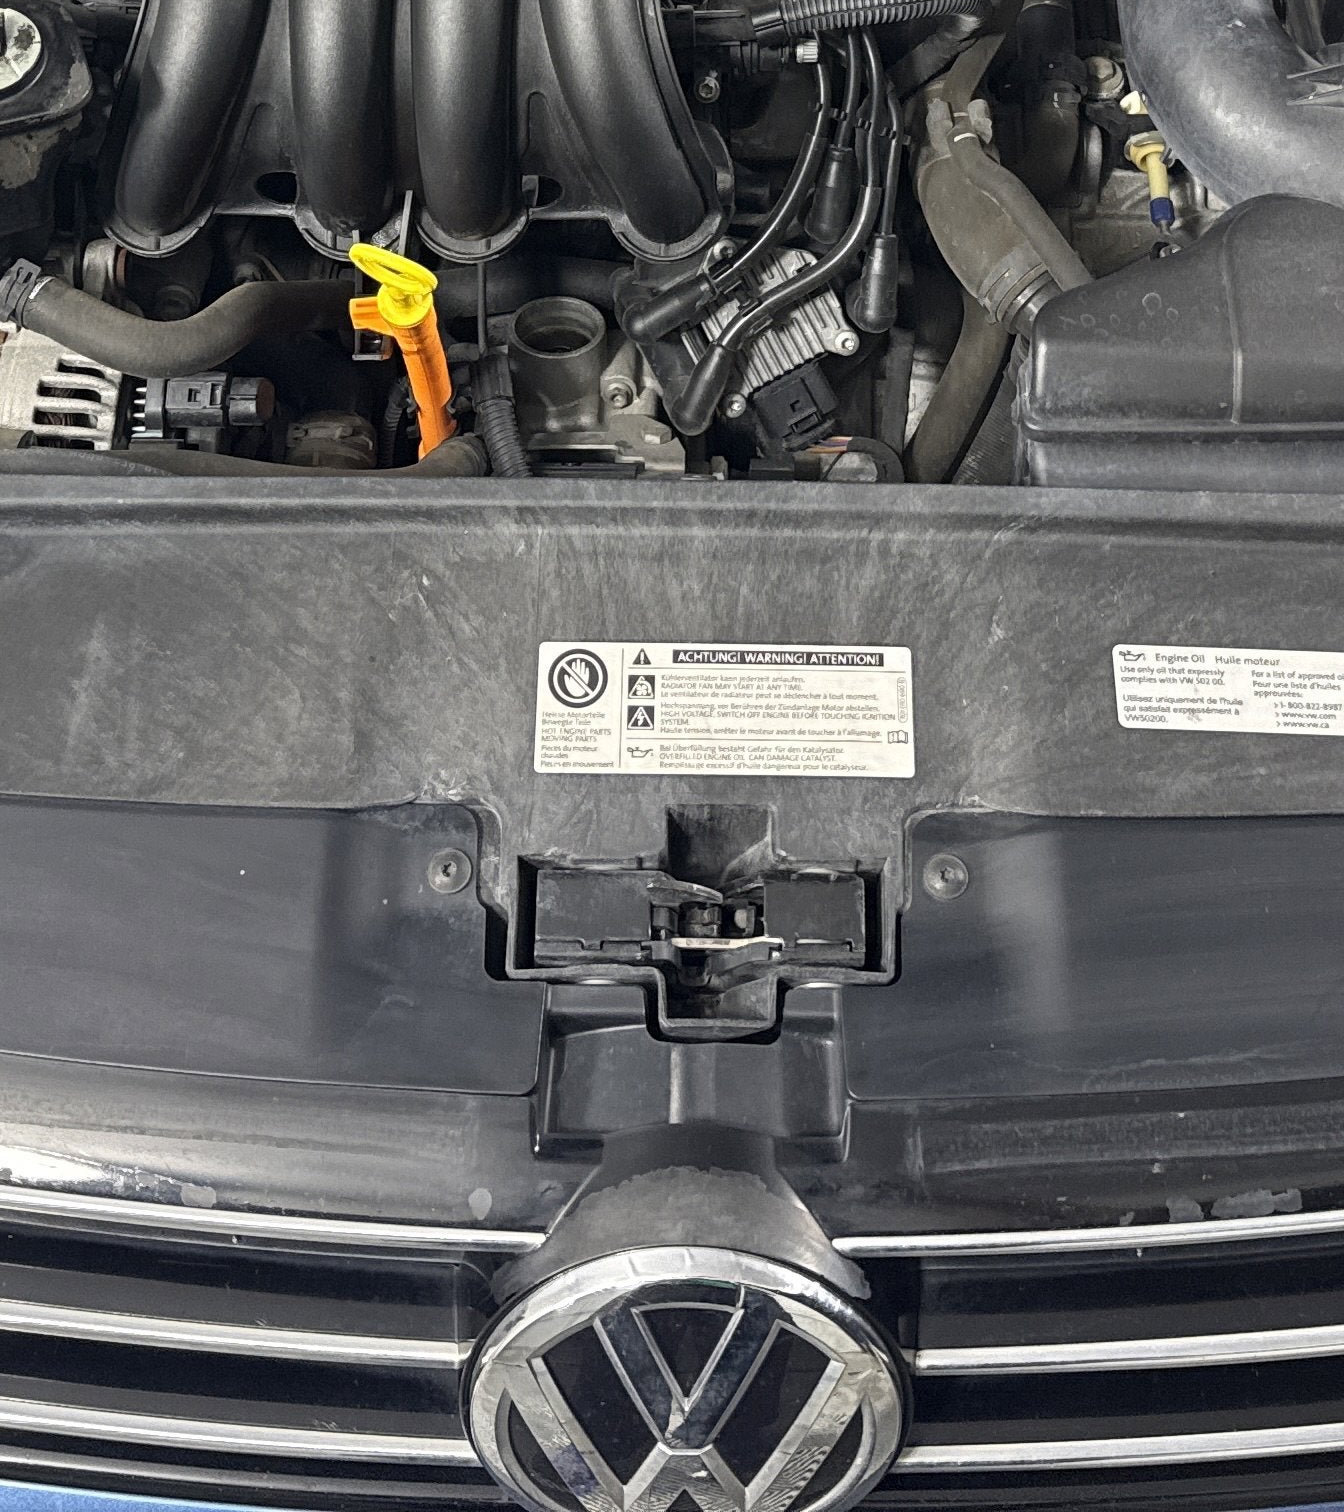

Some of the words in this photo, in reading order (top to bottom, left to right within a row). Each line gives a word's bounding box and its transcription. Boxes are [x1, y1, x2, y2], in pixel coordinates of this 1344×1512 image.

[677, 651, 740, 663] ACHTUNG!
[744, 652, 806, 664] WARNING!
[810, 653, 880, 665] ATTENTION!
[1155, 653, 1189, 664] Engine
[1191, 654, 1205, 663] Oil
[1215, 655, 1241, 664] Huile
[1243, 656, 1280, 666] moteur
[1137, 666, 1154, 675] only
[1168, 667, 1185, 675] that
[1187, 669, 1225, 677] expressly
[1251, 670, 1265, 678] For
[1273, 670, 1285, 679] list
[1287, 670, 1297, 679] of
[1297, 672, 1335, 681] approved
[1121, 675, 1157, 684] complies
[1159, 676, 1177, 684] with
[1179, 677, 1194, 685] VW
[1252, 680, 1272, 688] Pour
[1206, 696, 1217, 704] de
